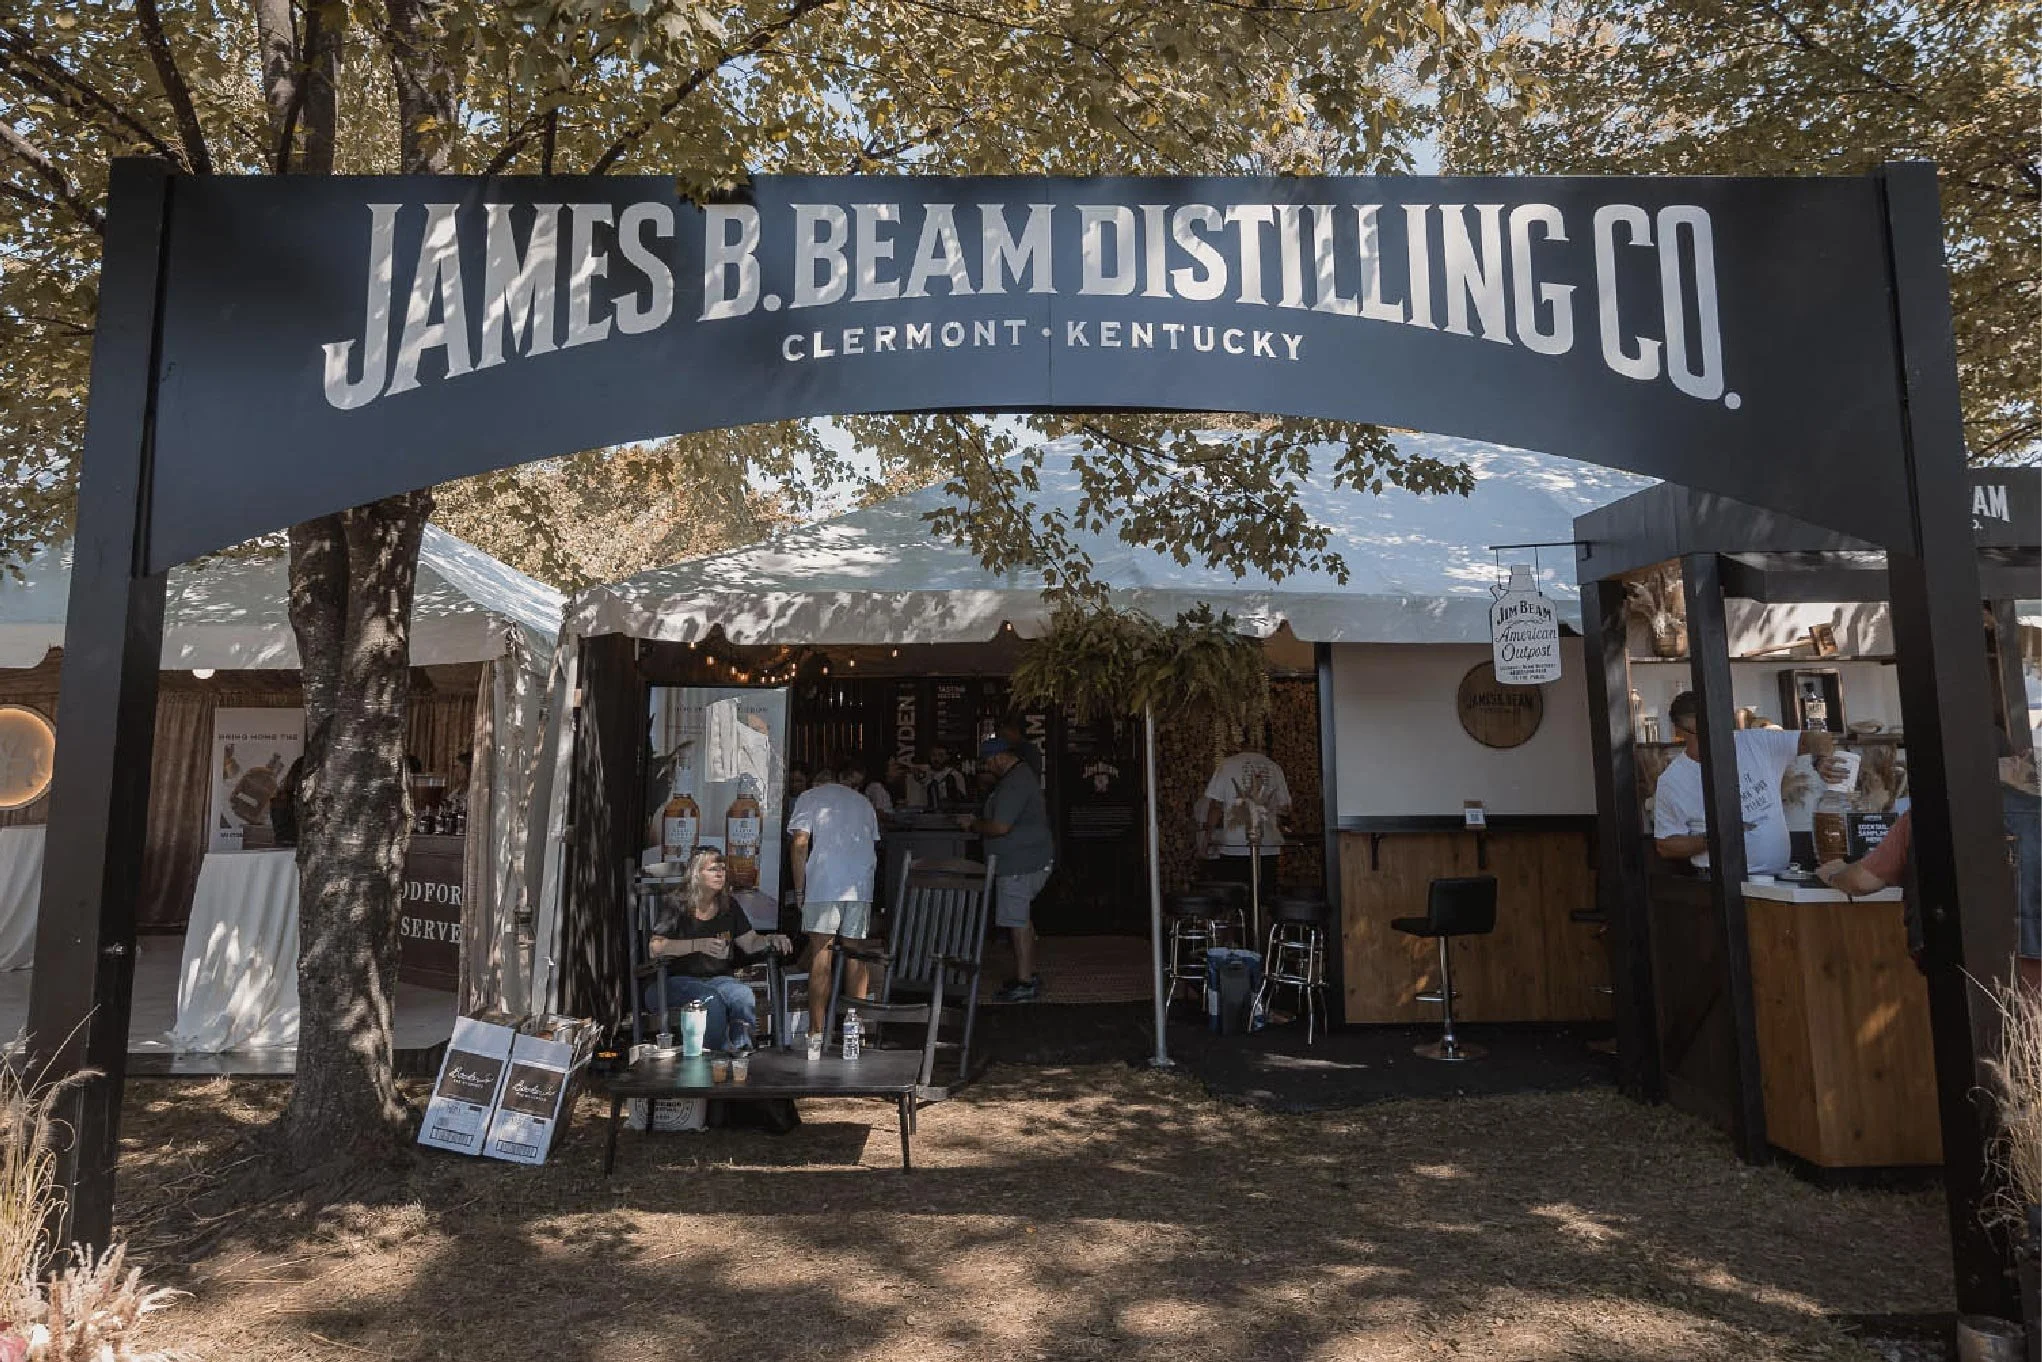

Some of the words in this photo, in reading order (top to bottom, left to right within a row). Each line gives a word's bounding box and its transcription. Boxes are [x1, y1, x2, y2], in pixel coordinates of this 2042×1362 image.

[322, 202, 674, 410] JAMES
[698, 203, 781, 321] B.
[788, 202, 1057, 309] BEAM
[1076, 203, 1574, 355] DISTILLING
[1592, 203, 1742, 410] CO.
[782, 319, 1028, 363] CLERMONT
[1066, 320, 1304, 362] KENTUCKY
[1497, 604, 1518, 625] JIM
[1519, 600, 1551, 621] BEAM
[1494, 626, 1558, 643] American
[1501, 642, 1552, 662] Outpost
[402, 880, 462, 906] DFOR
